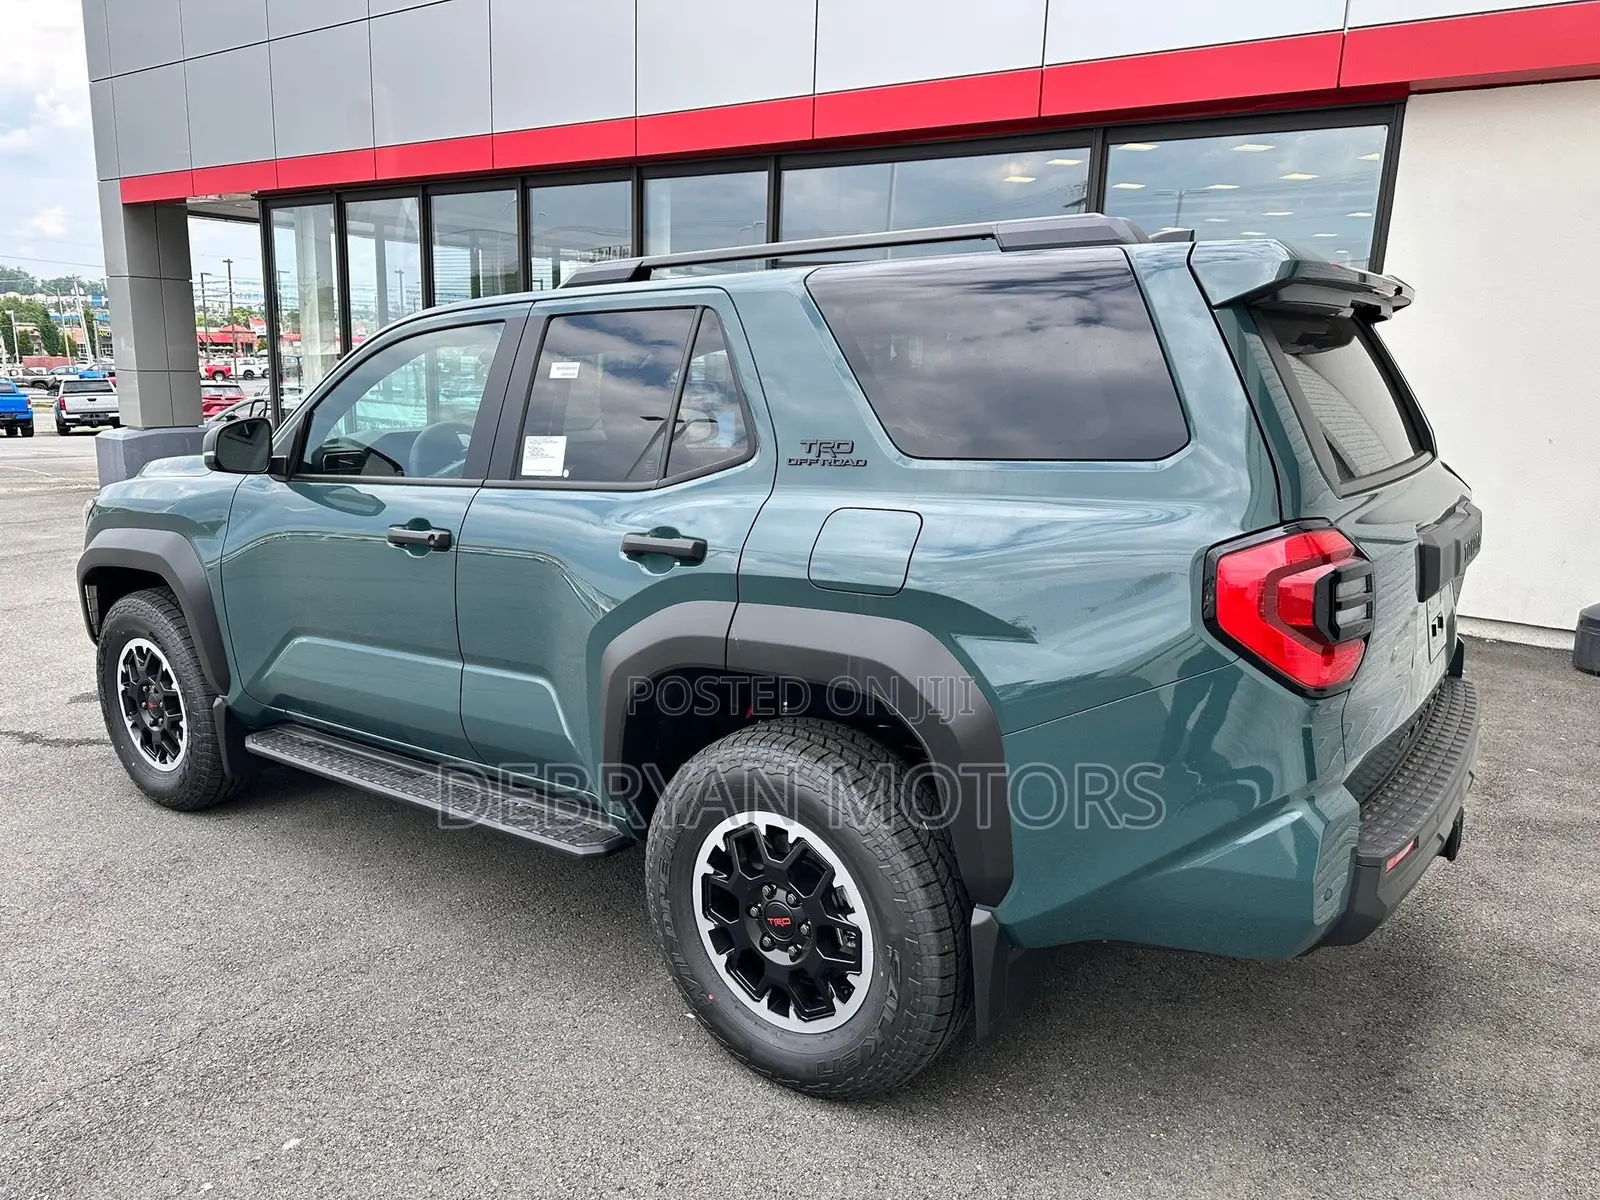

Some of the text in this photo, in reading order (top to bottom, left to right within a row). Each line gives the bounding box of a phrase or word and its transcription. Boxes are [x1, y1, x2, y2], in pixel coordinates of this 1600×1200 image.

[800, 439, 854, 458] TRD
[787, 458, 868, 467] OFF ROAD
[767, 917, 791, 927] TRD
